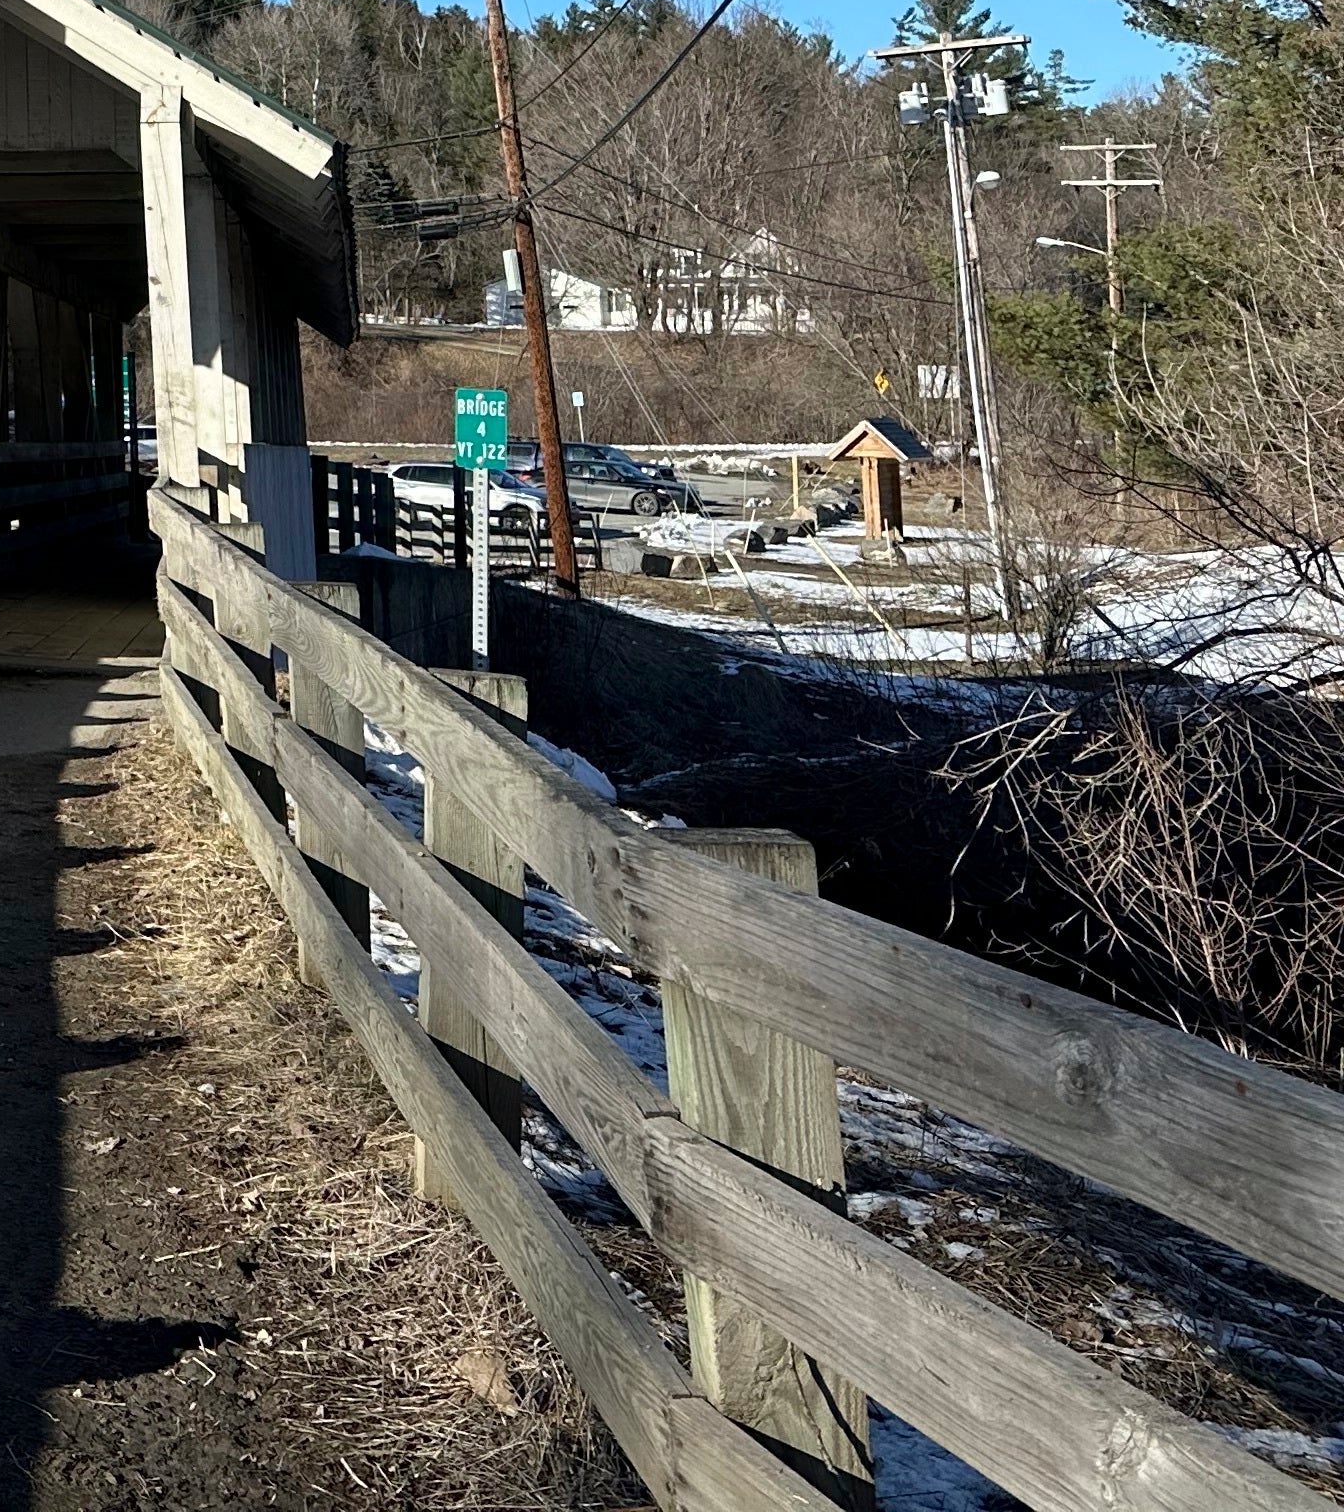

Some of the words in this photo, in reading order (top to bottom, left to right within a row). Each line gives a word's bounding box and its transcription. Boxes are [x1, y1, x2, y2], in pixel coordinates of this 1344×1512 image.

[457, 399, 505, 416] BRIDGE
[476, 421, 486, 437] 4
[457, 442, 473, 458] VT
[481, 443, 505, 460] 122
